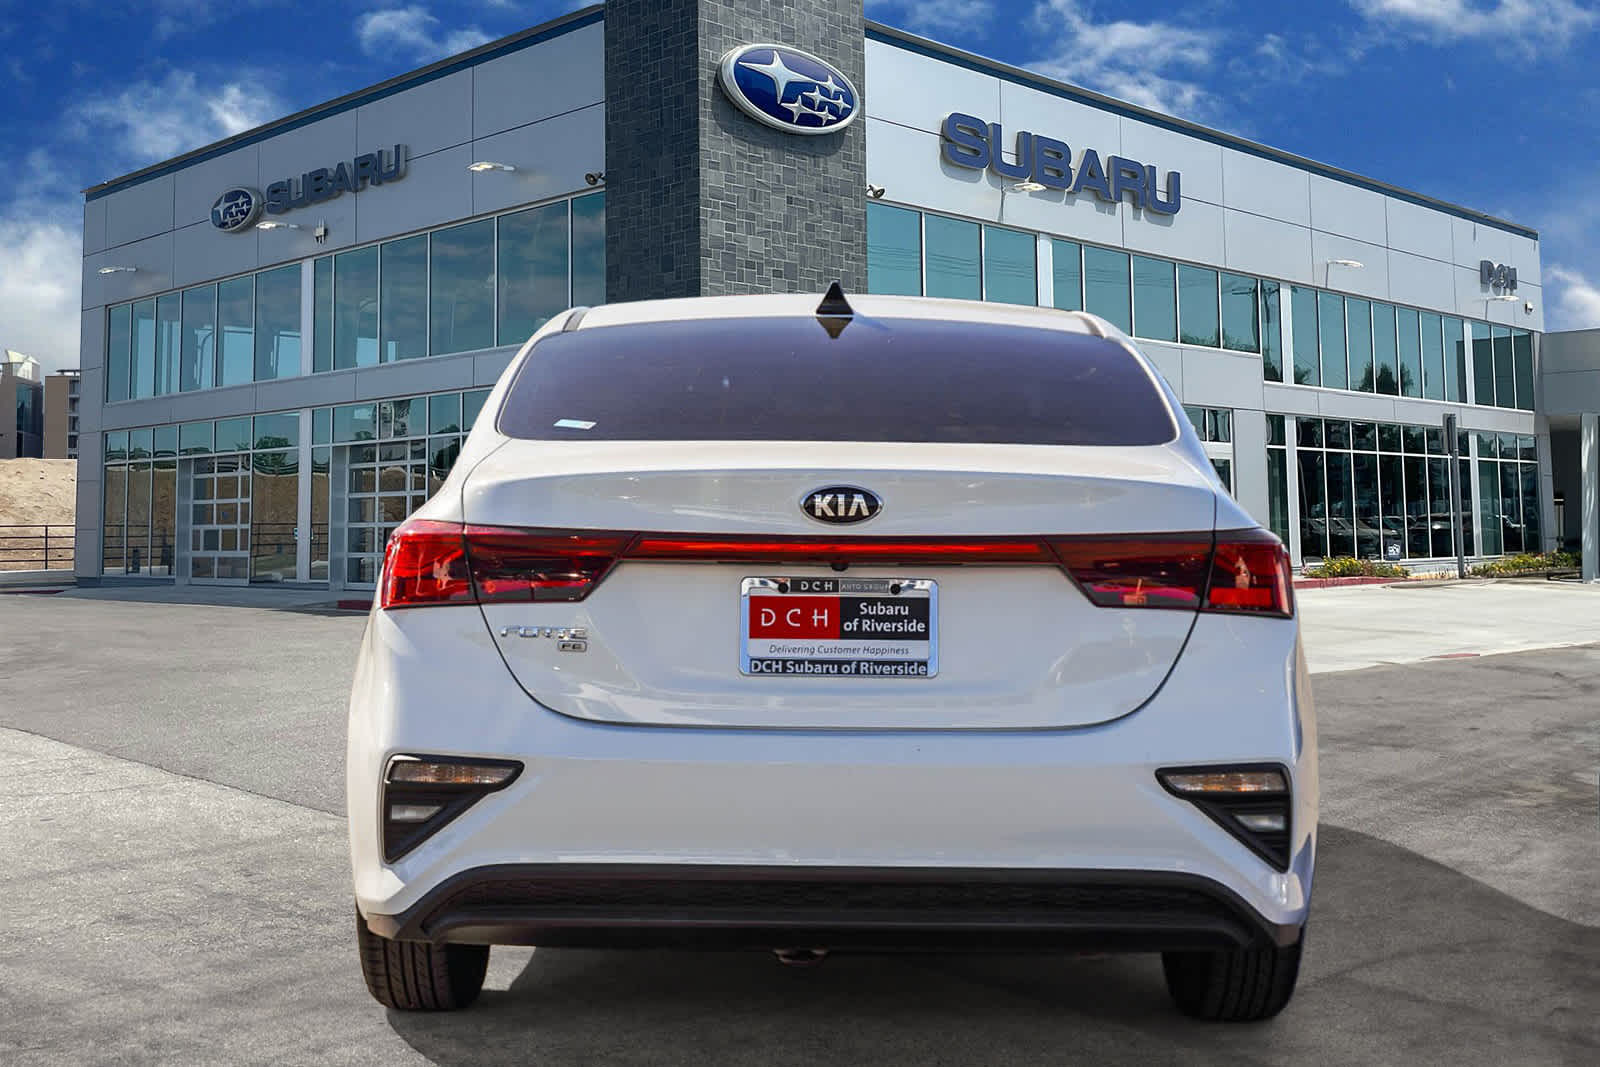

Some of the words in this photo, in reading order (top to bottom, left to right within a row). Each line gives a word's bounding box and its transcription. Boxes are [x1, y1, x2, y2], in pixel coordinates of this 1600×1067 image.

[942, 112, 1181, 216] SUBARU
[266, 143, 408, 215] SUBARU
[813, 493, 870, 517] KIA
[800, 581, 833, 591] DCH
[859, 602, 909, 616] Subaru
[760, 608, 829, 628] DCH
[843, 619, 859, 632] of
[862, 619, 926, 633] Riverside
[769, 644, 816, 655] Delivering
[817, 645, 861, 655] Customer
[862, 645, 909, 656] Happiness
[751, 659, 783, 673] DCH
[786, 659, 839, 674] Subaru
[841, 660, 858, 674] of
[860, 661, 928, 676] Riverside
